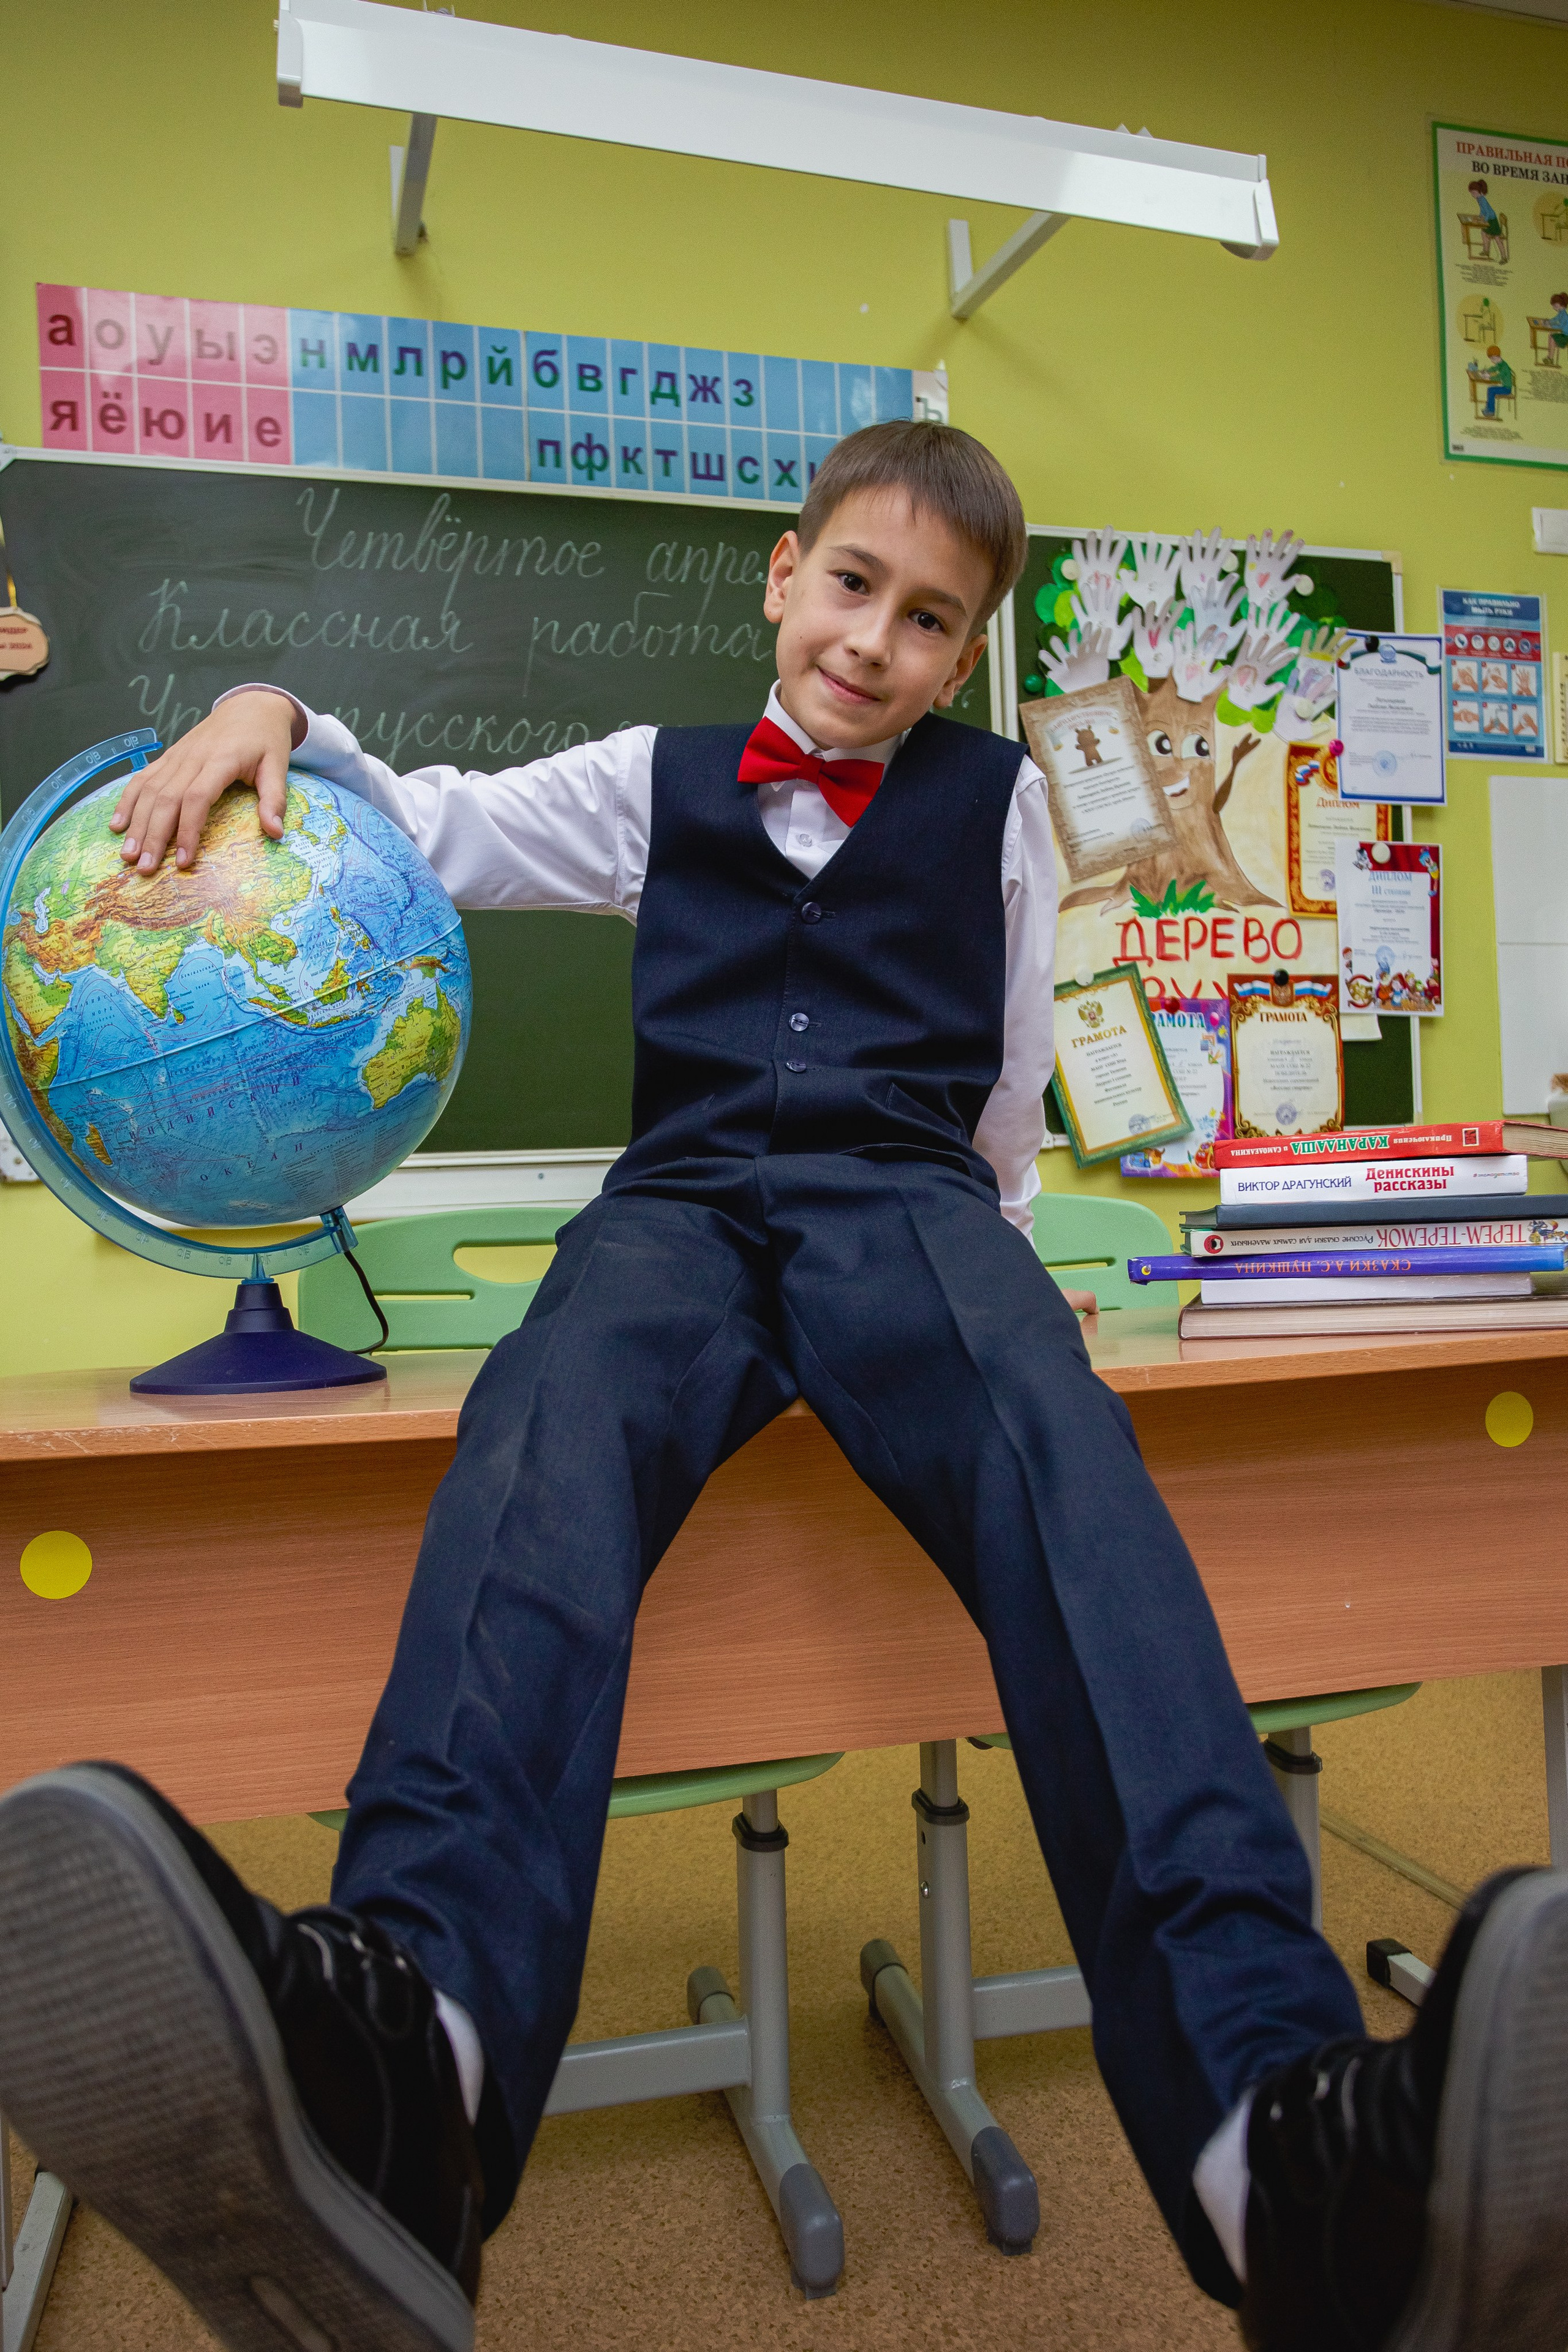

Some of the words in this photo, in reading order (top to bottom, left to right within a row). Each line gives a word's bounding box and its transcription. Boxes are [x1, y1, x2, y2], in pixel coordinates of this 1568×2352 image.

[1456, 141, 1553, 167] ПРАВИЛЬНАЯ
[1472, 160, 1490, 174] ВО
[1493, 164, 1540, 182] ВРЕМЯ
[47, 314, 75, 347] а
[96, 318, 124, 350] о
[146, 325, 175, 366] у
[196, 328, 236, 363] ы
[252, 333, 278, 364] э
[300, 339, 325, 369] н
[347, 342, 380, 373] м
[394, 348, 423, 377] л
[442, 350, 467, 388] р
[486, 345, 513, 386] й
[533, 349, 559, 388] б
[577, 363, 603, 392] в
[620, 368, 638, 395] г
[650, 371, 680, 406] д
[688, 375, 722, 404] ж
[733, 379, 755, 407] з
[49, 399, 79, 431] я
[99, 392, 127, 434] ё
[143, 407, 186, 440] ю
[205, 412, 233, 443] и
[255, 416, 283, 447] е
[537, 439, 562, 468] п
[571, 433, 609, 481] ф
[622, 446, 644, 475] к
[655, 449, 677, 477] т
[691, 454, 725, 482] ш
[737, 455, 760, 484] с
[774, 458, 798, 488] х
[296, 488, 605, 616] Четвёртое
[138, 578, 473, 654] Классная
[524, 592, 773, 698] работа
[1112, 916, 1303, 968] ДЕРЕВО
[1259, 1011, 1308, 1022] ГРАМОТА
[1071, 1025, 1127, 1049] ГРАМОТА
[129, 1072, 300, 1140] ИНДИЙСКИЙ
[1231, 1146, 1282, 1156] САМОДЕЛКИНА
[1290, 1135, 1390, 1155] КАРАНДАША
[200, 1142, 303, 1182] ОКЕАН
[1238, 1181, 1280, 1191] ВИКТОР
[1282, 1176, 1352, 1191] ДРАГУНСКИЙ
[1365, 1166, 1454, 1182] Денискины
[1374, 1178, 1447, 1193] рассказы
[1299, 1235, 1313, 1244] для
[1342, 1234, 1374, 1244] Русские
[1376, 1224, 1526, 1248] ТЕРЕМ-ТЕРЕМОК
[1235, 1259, 1311, 1273] ПУШКИНА
[1350, 1259, 1411, 1272] СКАЗКИ
